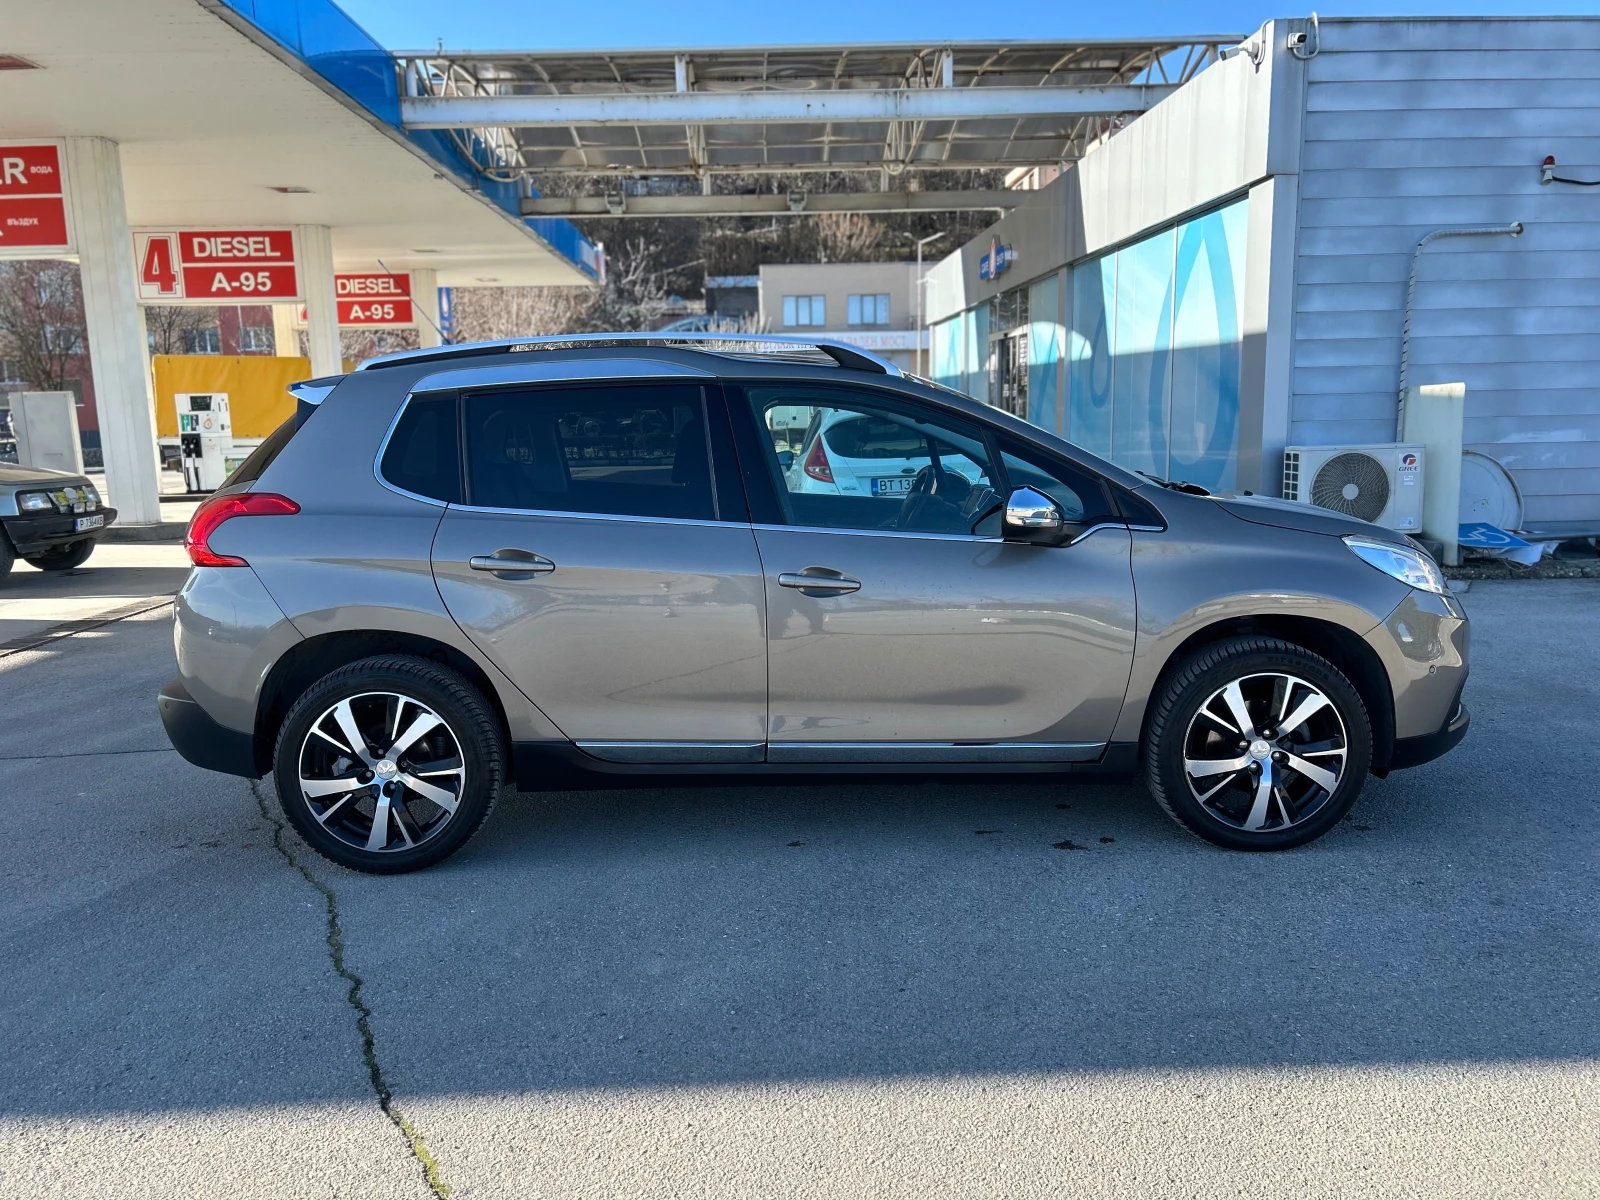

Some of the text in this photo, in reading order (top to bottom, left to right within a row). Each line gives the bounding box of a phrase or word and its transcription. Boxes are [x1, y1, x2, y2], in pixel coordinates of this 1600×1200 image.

[0, 157, 28, 185] R
[30, 166, 53, 174] ВОДА
[7, 217, 39, 226] ВЪЗДУХ
[192, 237, 281, 257] DIESEL
[141, 236, 179, 294] 4
[211, 272, 272, 292] A-95
[337, 278, 402, 294] DIESEL
[350, 304, 395, 319] A-95
[880, 480, 895, 491] BT
